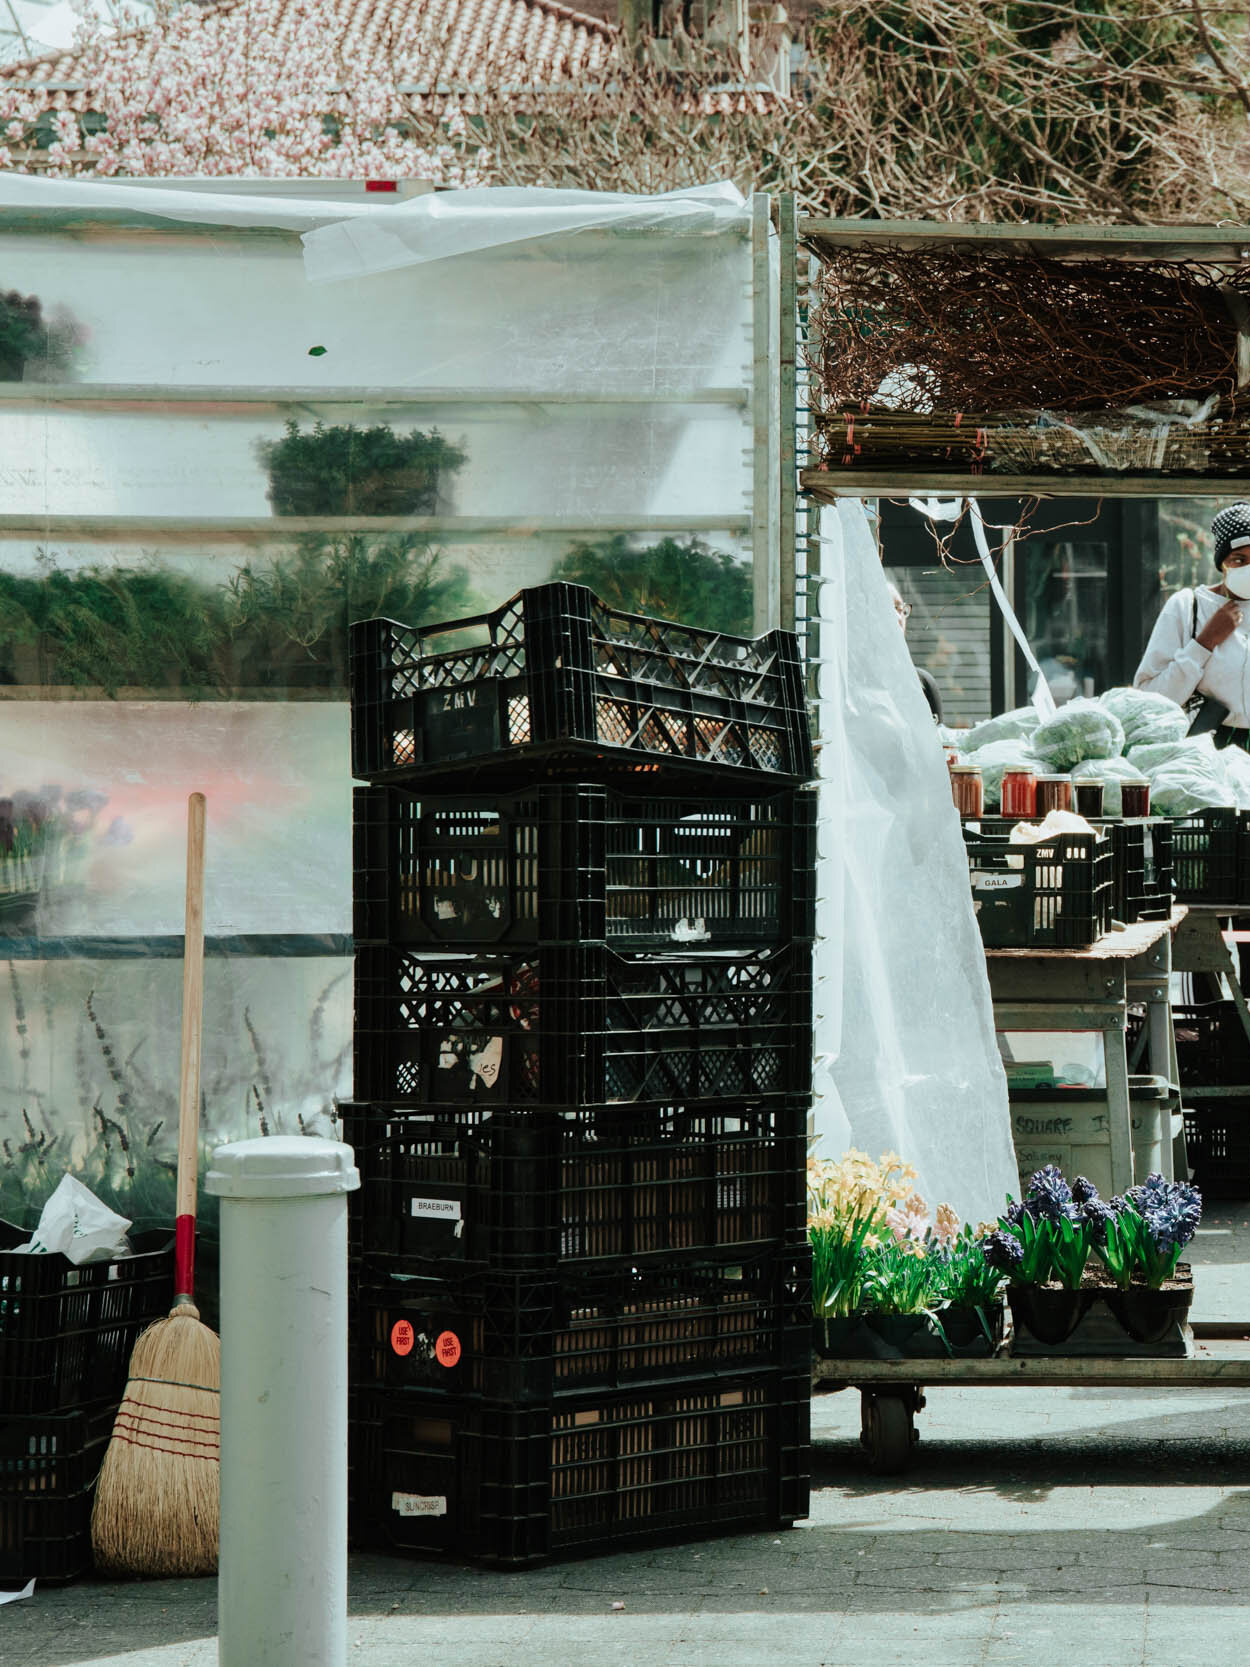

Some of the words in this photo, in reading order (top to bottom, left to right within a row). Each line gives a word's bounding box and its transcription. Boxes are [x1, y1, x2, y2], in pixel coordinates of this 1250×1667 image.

[443, 689, 476, 710] ZMV
[1036, 848, 1055, 858] ZMV
[984, 879, 1008, 887] GALA
[1016, 1116, 1073, 1134] SQUARE
[418, 1201, 454, 1212] BRAEBURN
[399, 1326, 409, 1336] USE
[396, 1336, 410, 1346] FIRST
[443, 1337, 454, 1347] USE
[441, 1347, 457, 1358] FIRST
